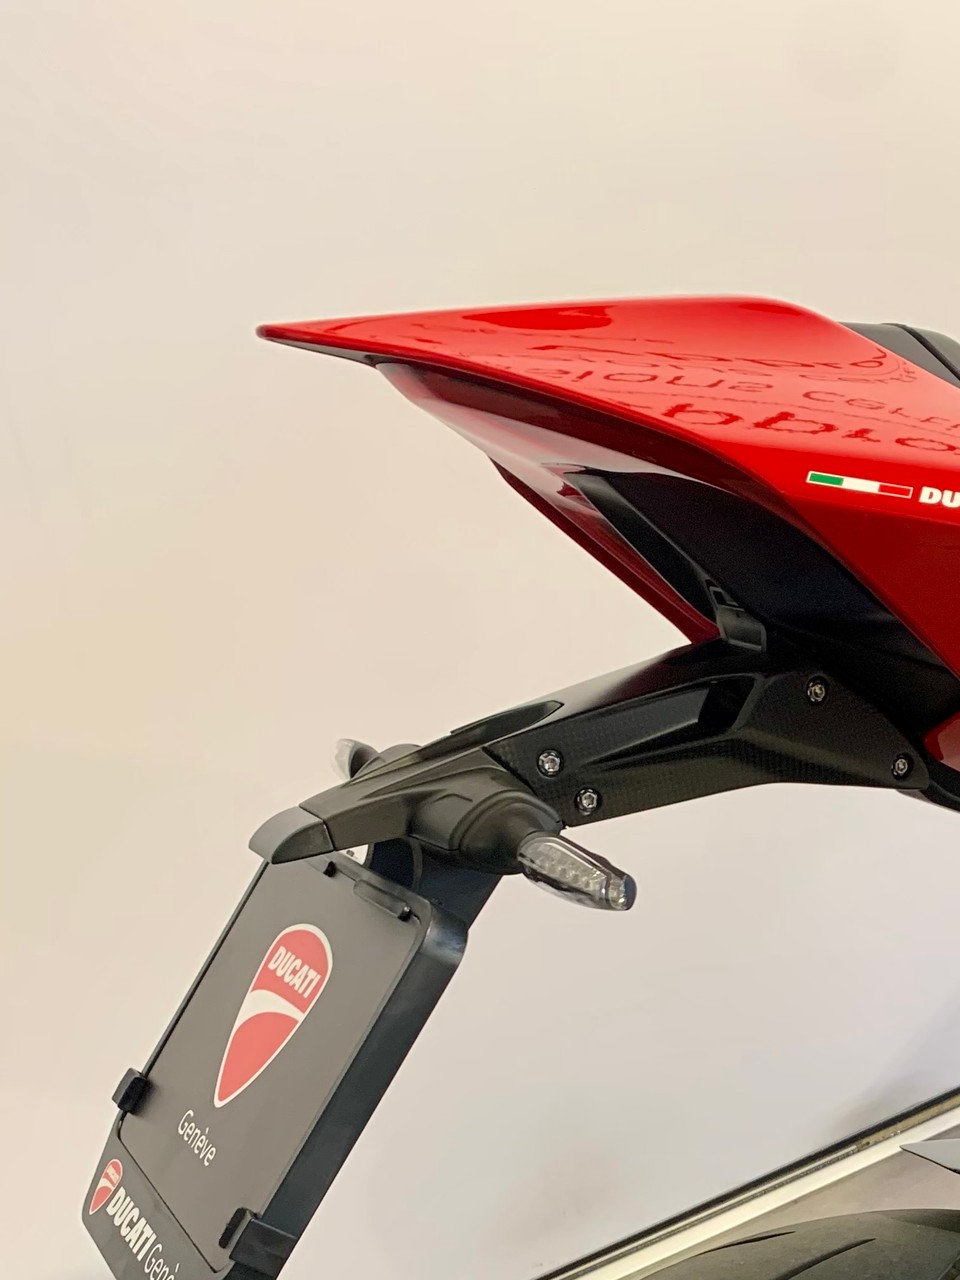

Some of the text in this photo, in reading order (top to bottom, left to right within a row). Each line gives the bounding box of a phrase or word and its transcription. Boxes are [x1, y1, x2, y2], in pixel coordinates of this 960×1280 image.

[267, 945, 321, 1000] DUCATI
[177, 1109, 217, 1167] Genève
[106, 1186, 157, 1262] DUCATI
